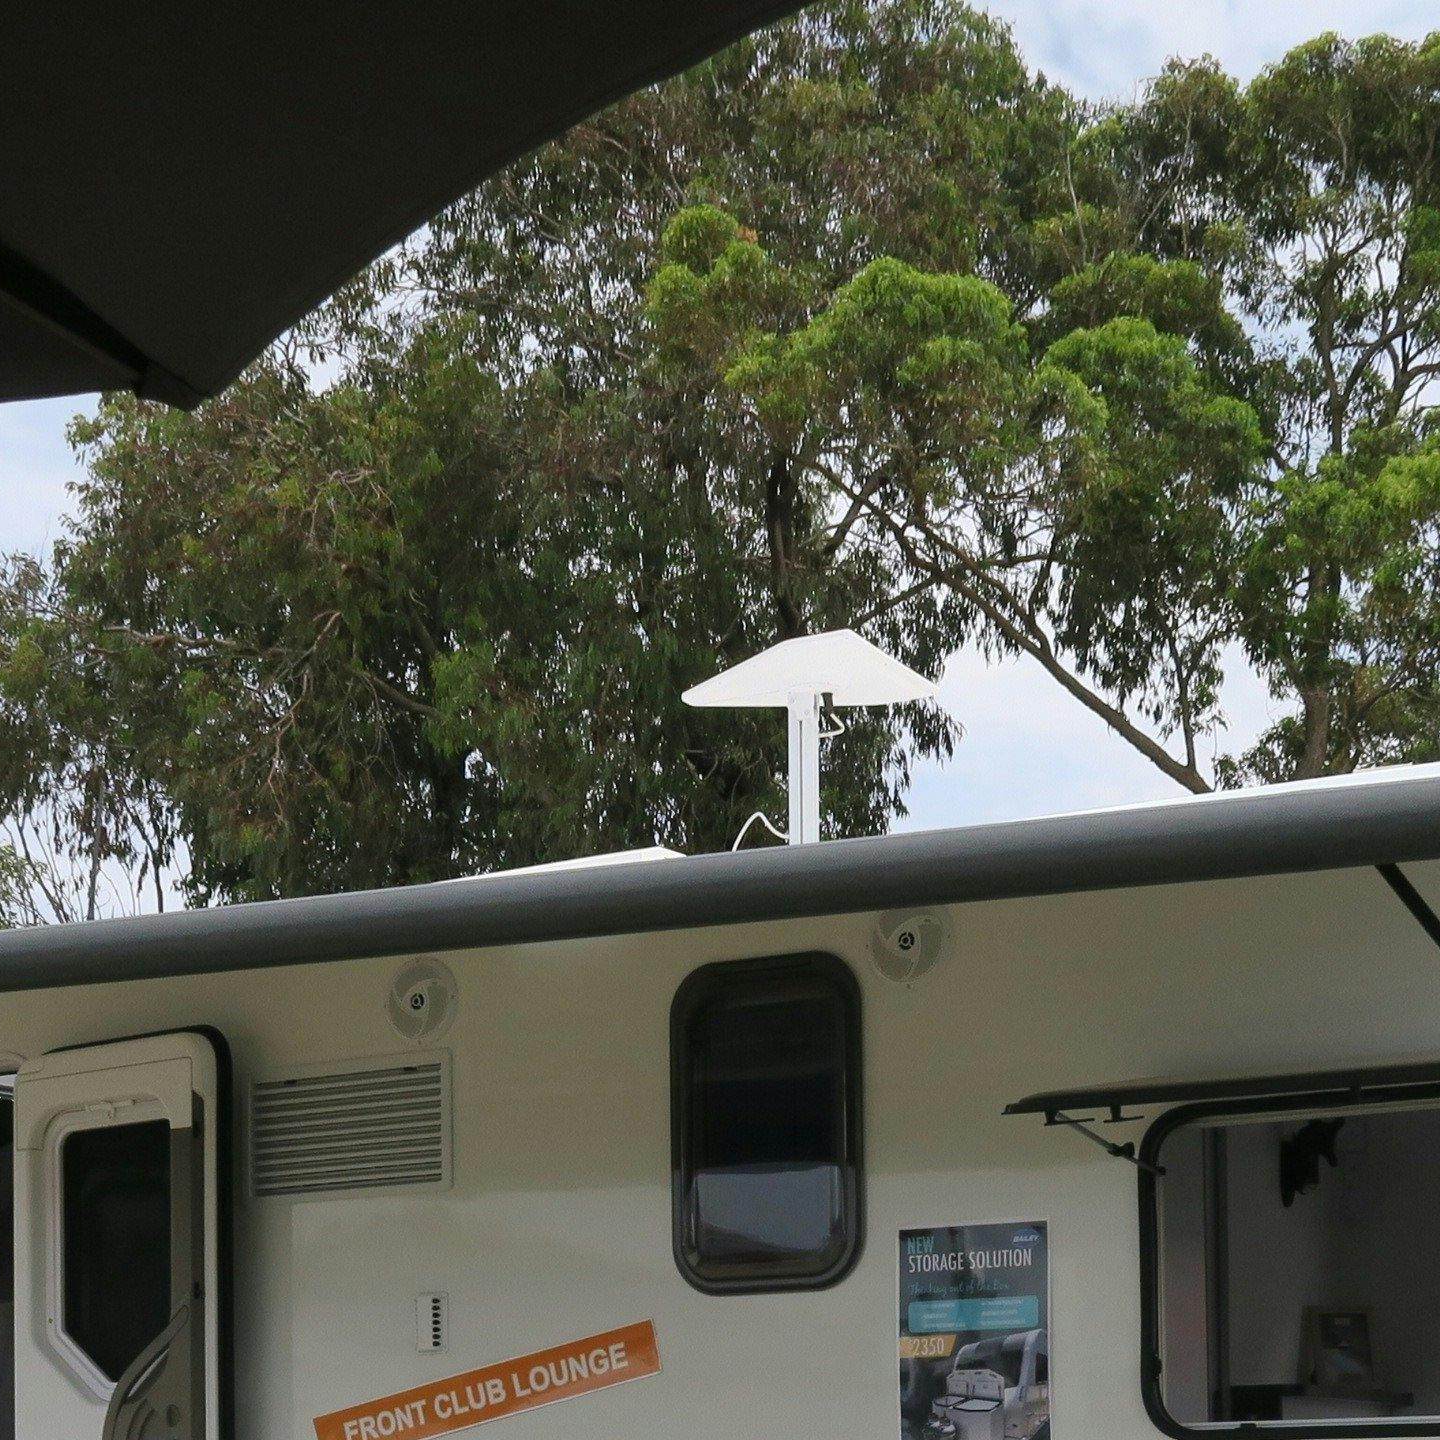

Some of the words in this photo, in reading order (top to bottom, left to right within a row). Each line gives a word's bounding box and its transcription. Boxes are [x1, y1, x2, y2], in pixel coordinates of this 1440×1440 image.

[907, 1236, 934, 1253] NEW
[909, 1252, 964, 1273] STORAGE
[968, 1248, 1033, 1269] SOLUTION
[434, 1377, 507, 1419] CLUB
[511, 1341, 630, 1397] LOUNGE
